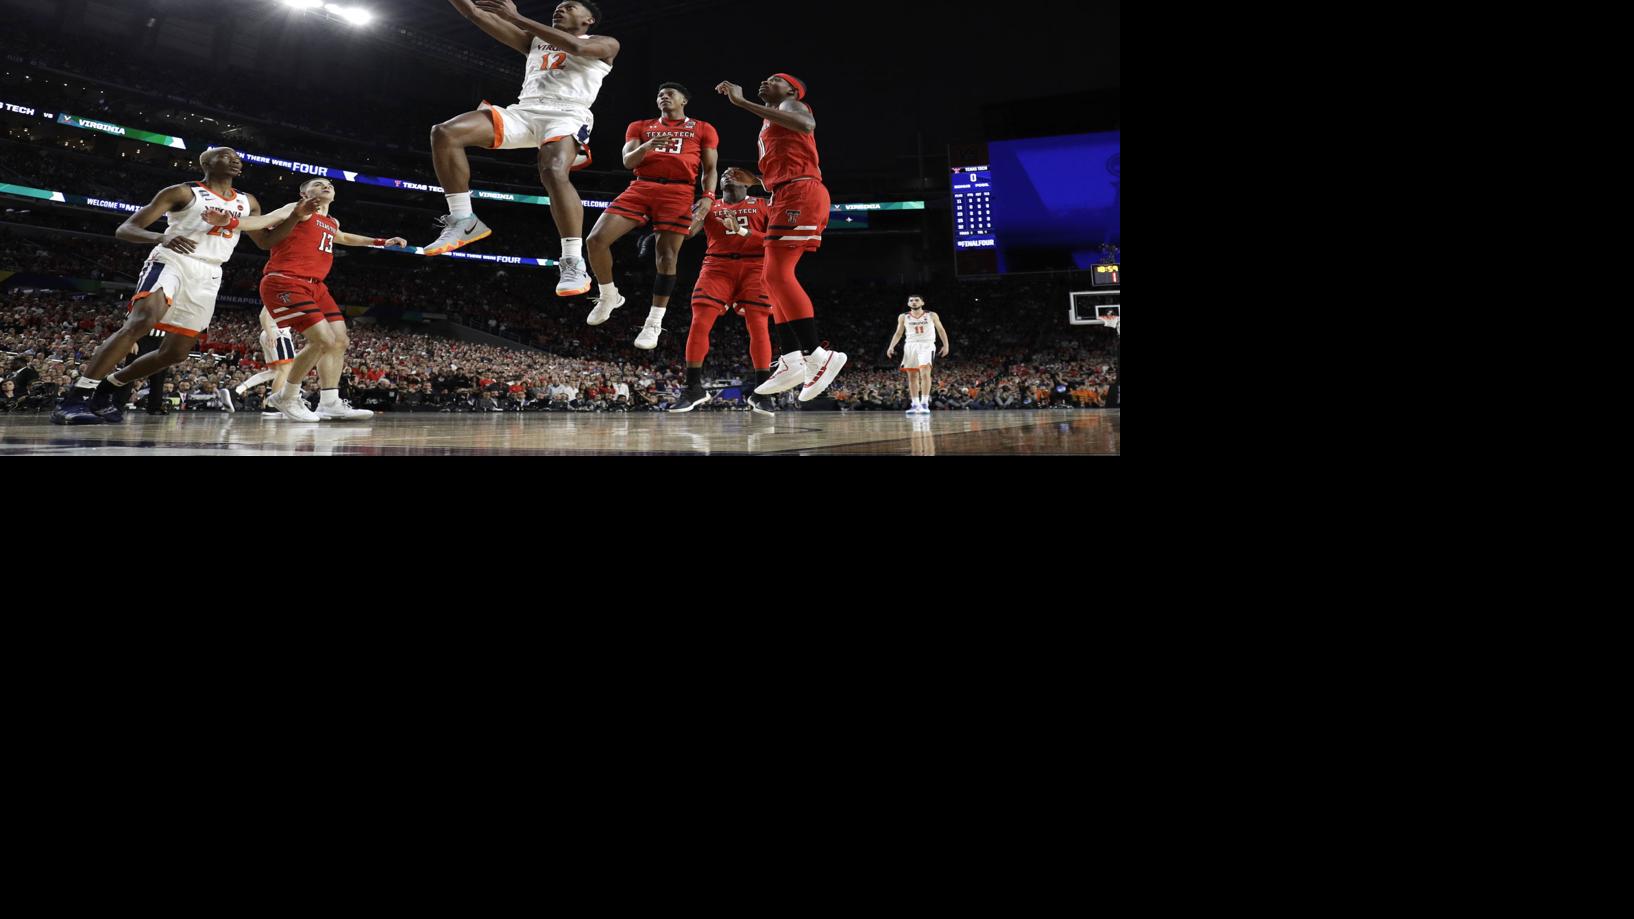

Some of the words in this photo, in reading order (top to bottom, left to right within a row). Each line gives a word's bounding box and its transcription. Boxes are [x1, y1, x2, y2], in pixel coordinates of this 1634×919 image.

[540, 52, 567, 70] 12
[5, 103, 35, 116] TECH
[78, 119, 125, 135] VIRGINIA
[654, 138, 683, 154] 3
[246, 153, 270, 164] THERE
[271, 158, 292, 168] WERE
[292, 162, 328, 177] FOUR
[403, 181, 428, 191] TEXAS
[479, 191, 515, 201] VIRGINIA
[87, 198, 118, 209] WELCOME
[713, 208, 737, 216] TEXS
[318, 231, 334, 254] 13
[914, 326, 924, 335] 11
